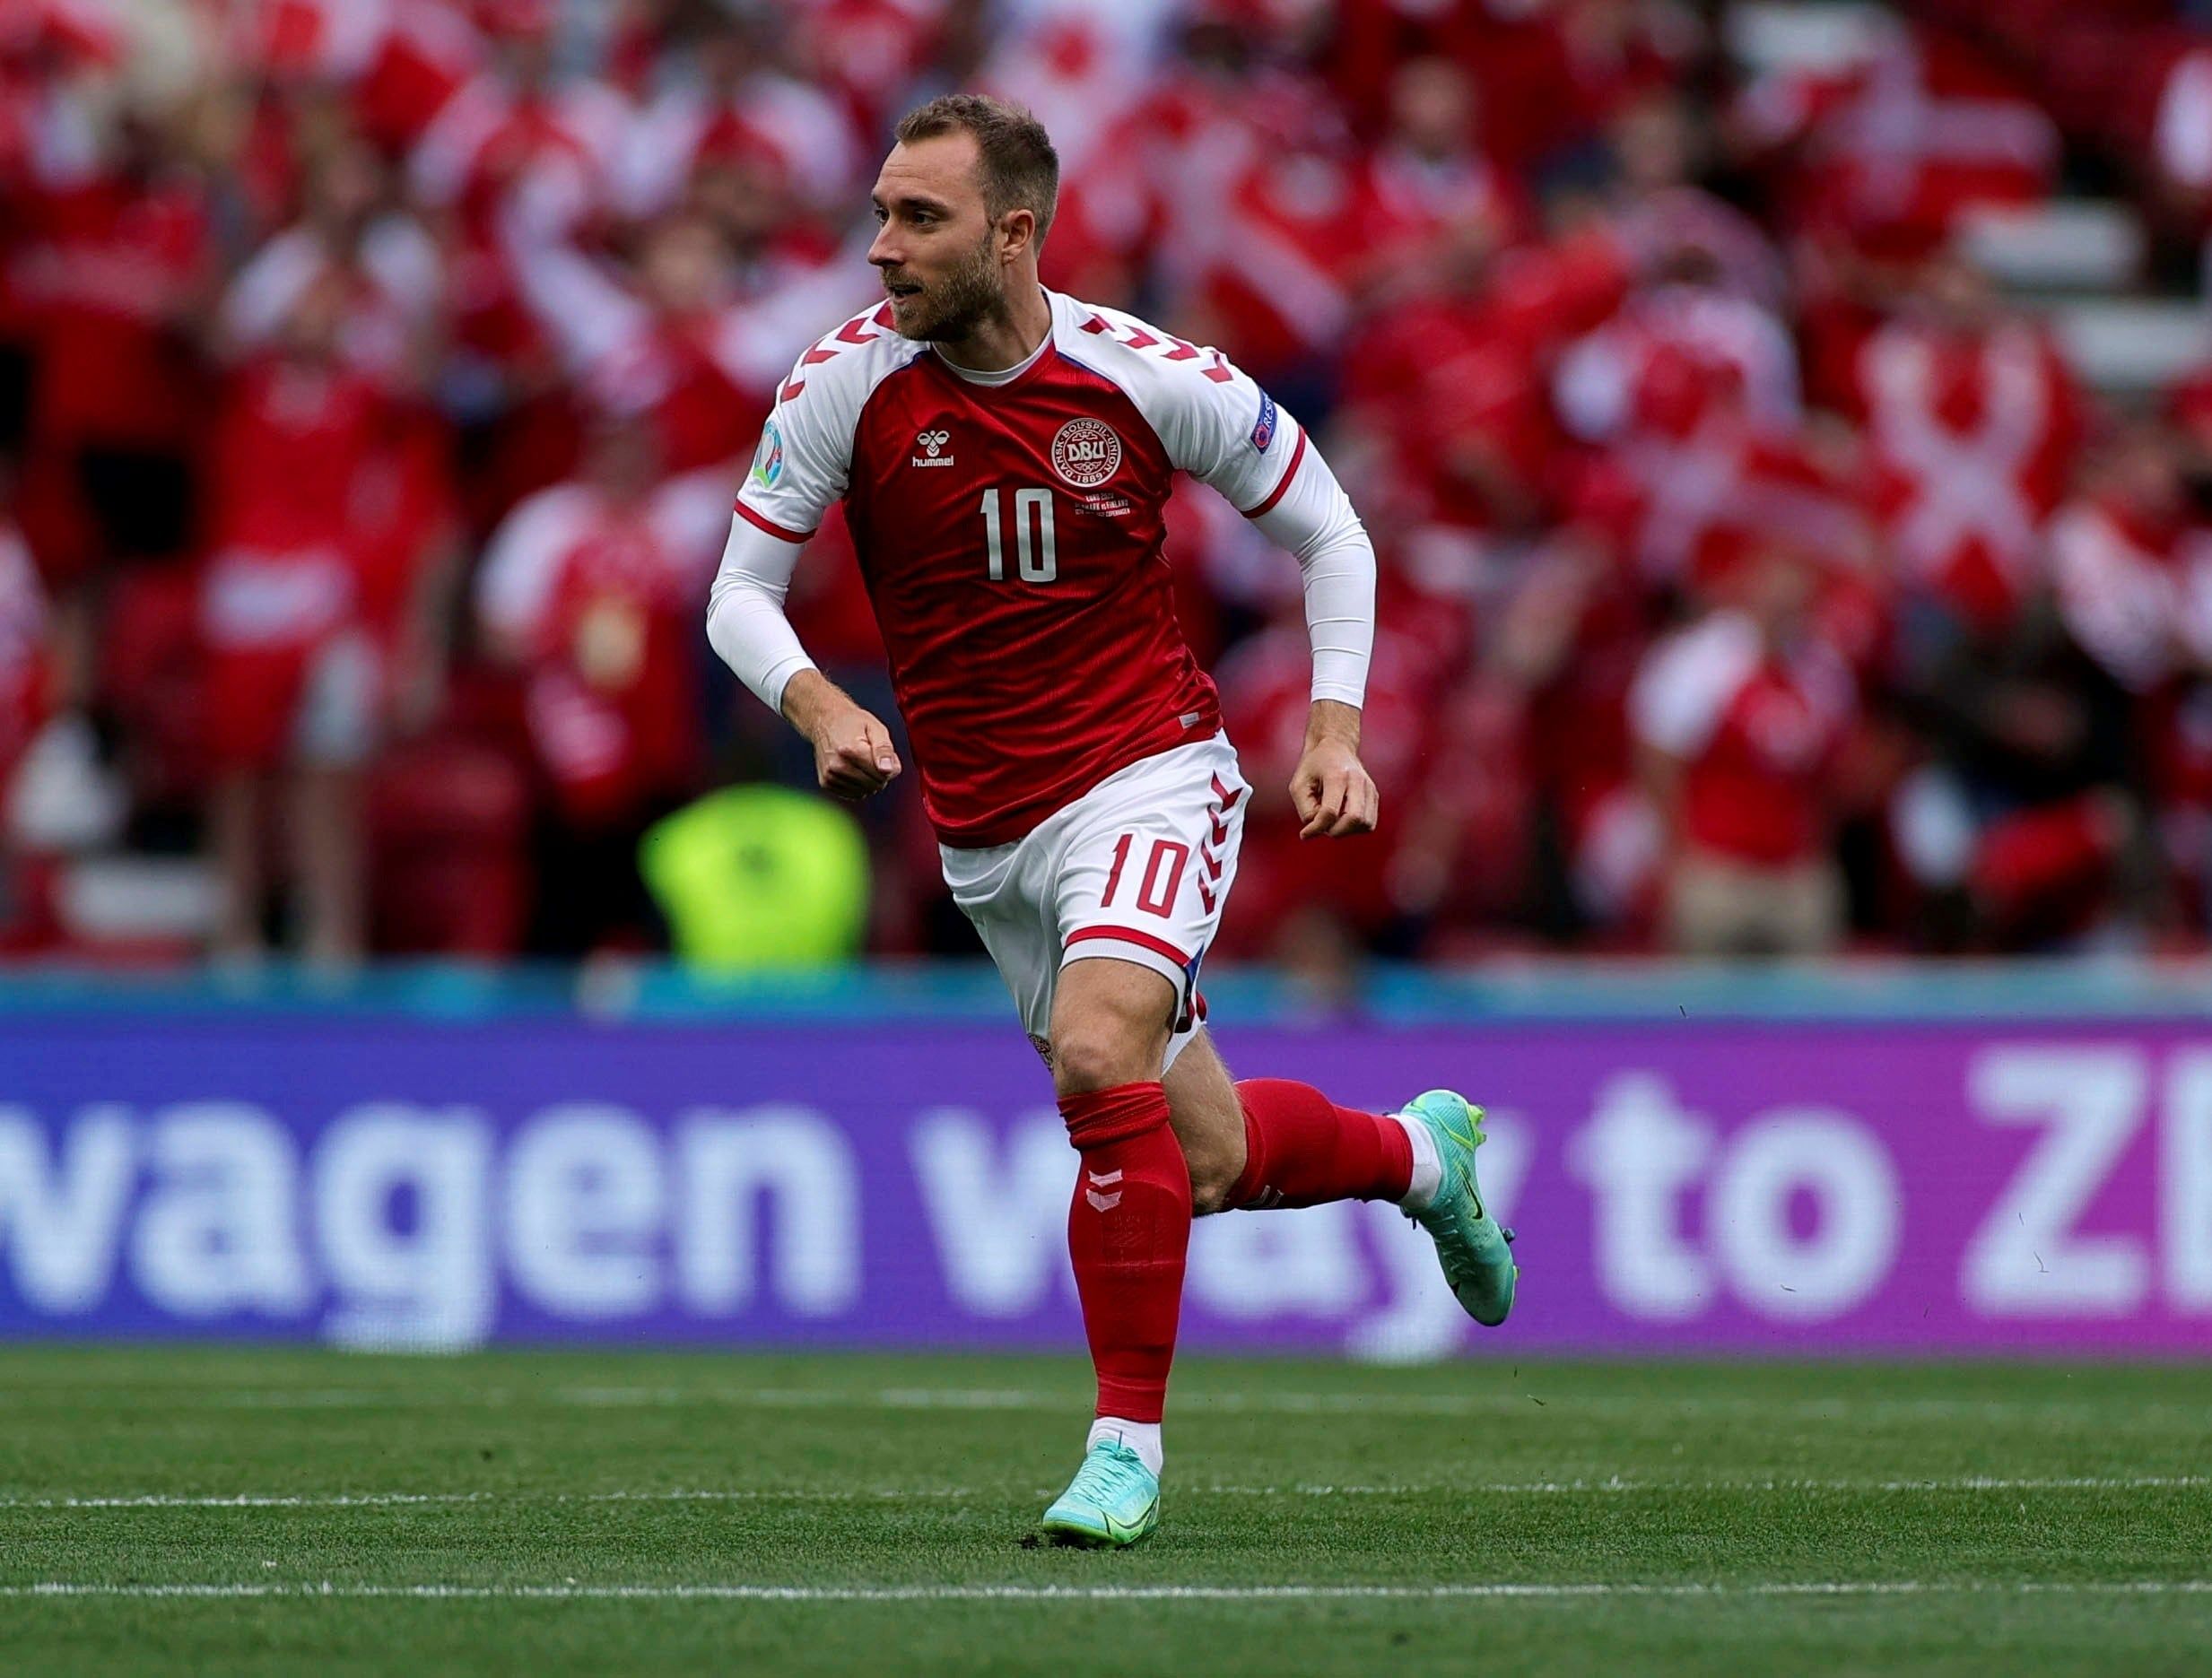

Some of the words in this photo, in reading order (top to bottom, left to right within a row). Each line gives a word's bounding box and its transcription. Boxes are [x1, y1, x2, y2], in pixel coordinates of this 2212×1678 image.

[912, 455, 954, 467] hummel
[1056, 441, 1074, 478] DANSK
[1067, 440, 1106, 462] DBU
[1104, 437, 1118, 473] UNION
[1076, 474, 1102, 483] 1889
[980, 488, 1057, 582] 10
[1101, 833, 1189, 919] 10
[1563, 1074, 1900, 1322] to
